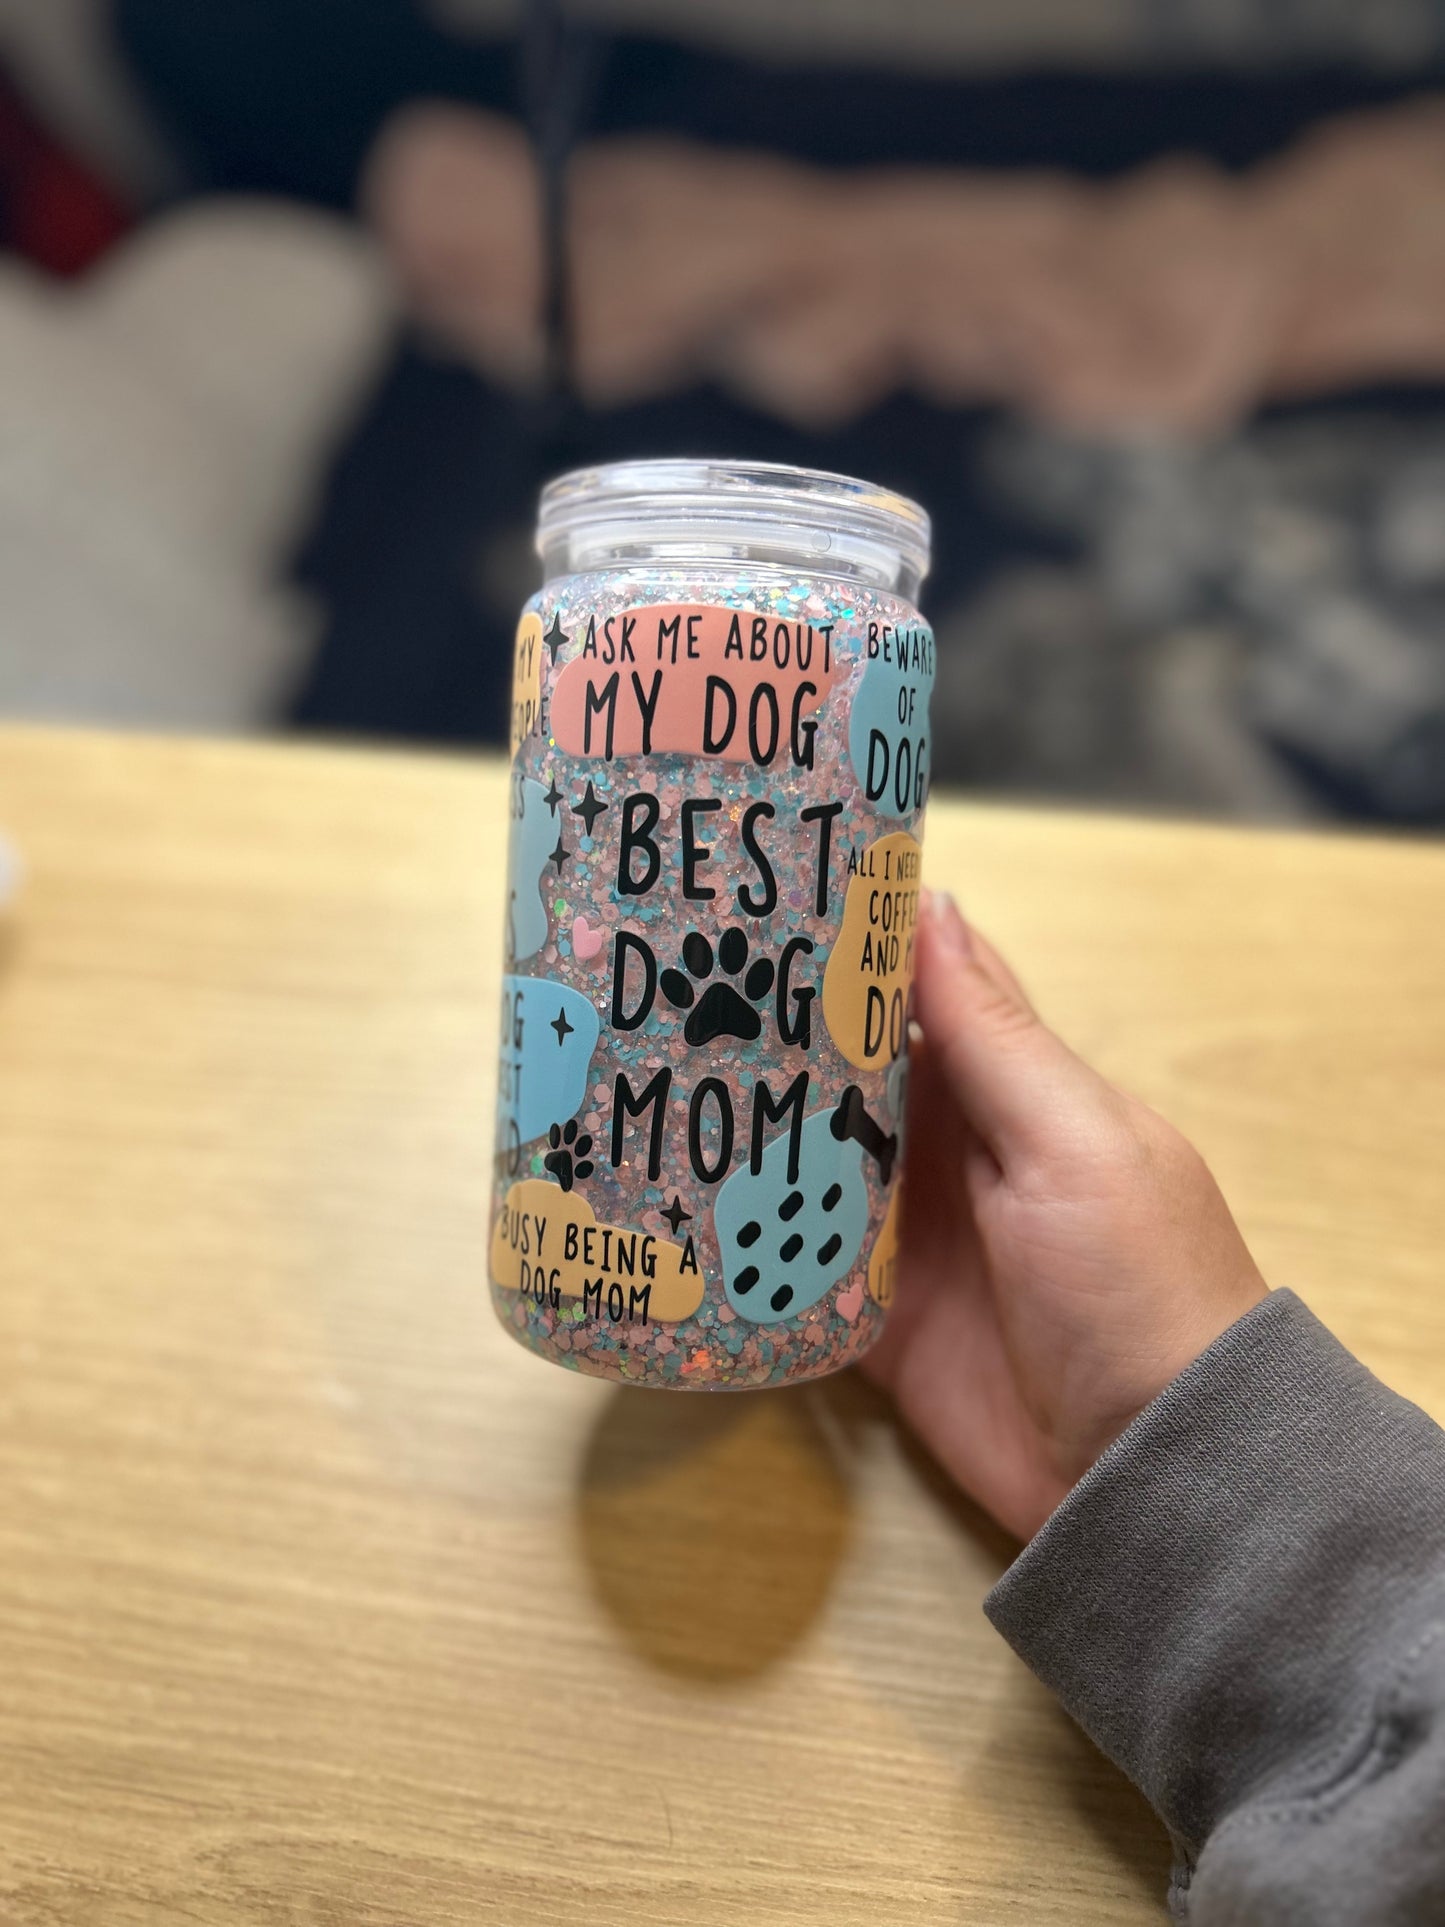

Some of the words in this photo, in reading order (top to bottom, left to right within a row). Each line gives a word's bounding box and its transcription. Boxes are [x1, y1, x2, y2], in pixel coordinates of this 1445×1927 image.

[582, 614, 635, 664] ASK
[656, 614, 702, 664] ME
[724, 613, 834, 673] ABOUT
[867, 622, 933, 676] BEWARE
[583, 669, 663, 762] MY
[702, 675, 819, 771] DOG
[897, 685, 916, 726] OF
[866, 728, 925, 813] DOG
[616, 792, 844, 918] BEST
[847, 846, 876, 878] ALL
[883, 850, 892, 881] I
[860, 931, 900, 977] AND
[863, 984, 915, 1061] DO
[611, 1066, 810, 1185] MOM
[501, 1203, 547, 1257] BUSY
[564, 1222, 658, 1279] BEING
[679, 1234, 698, 1275] A
[520, 1258, 562, 1311] DOG
[583, 1277, 652, 1327] MOM
